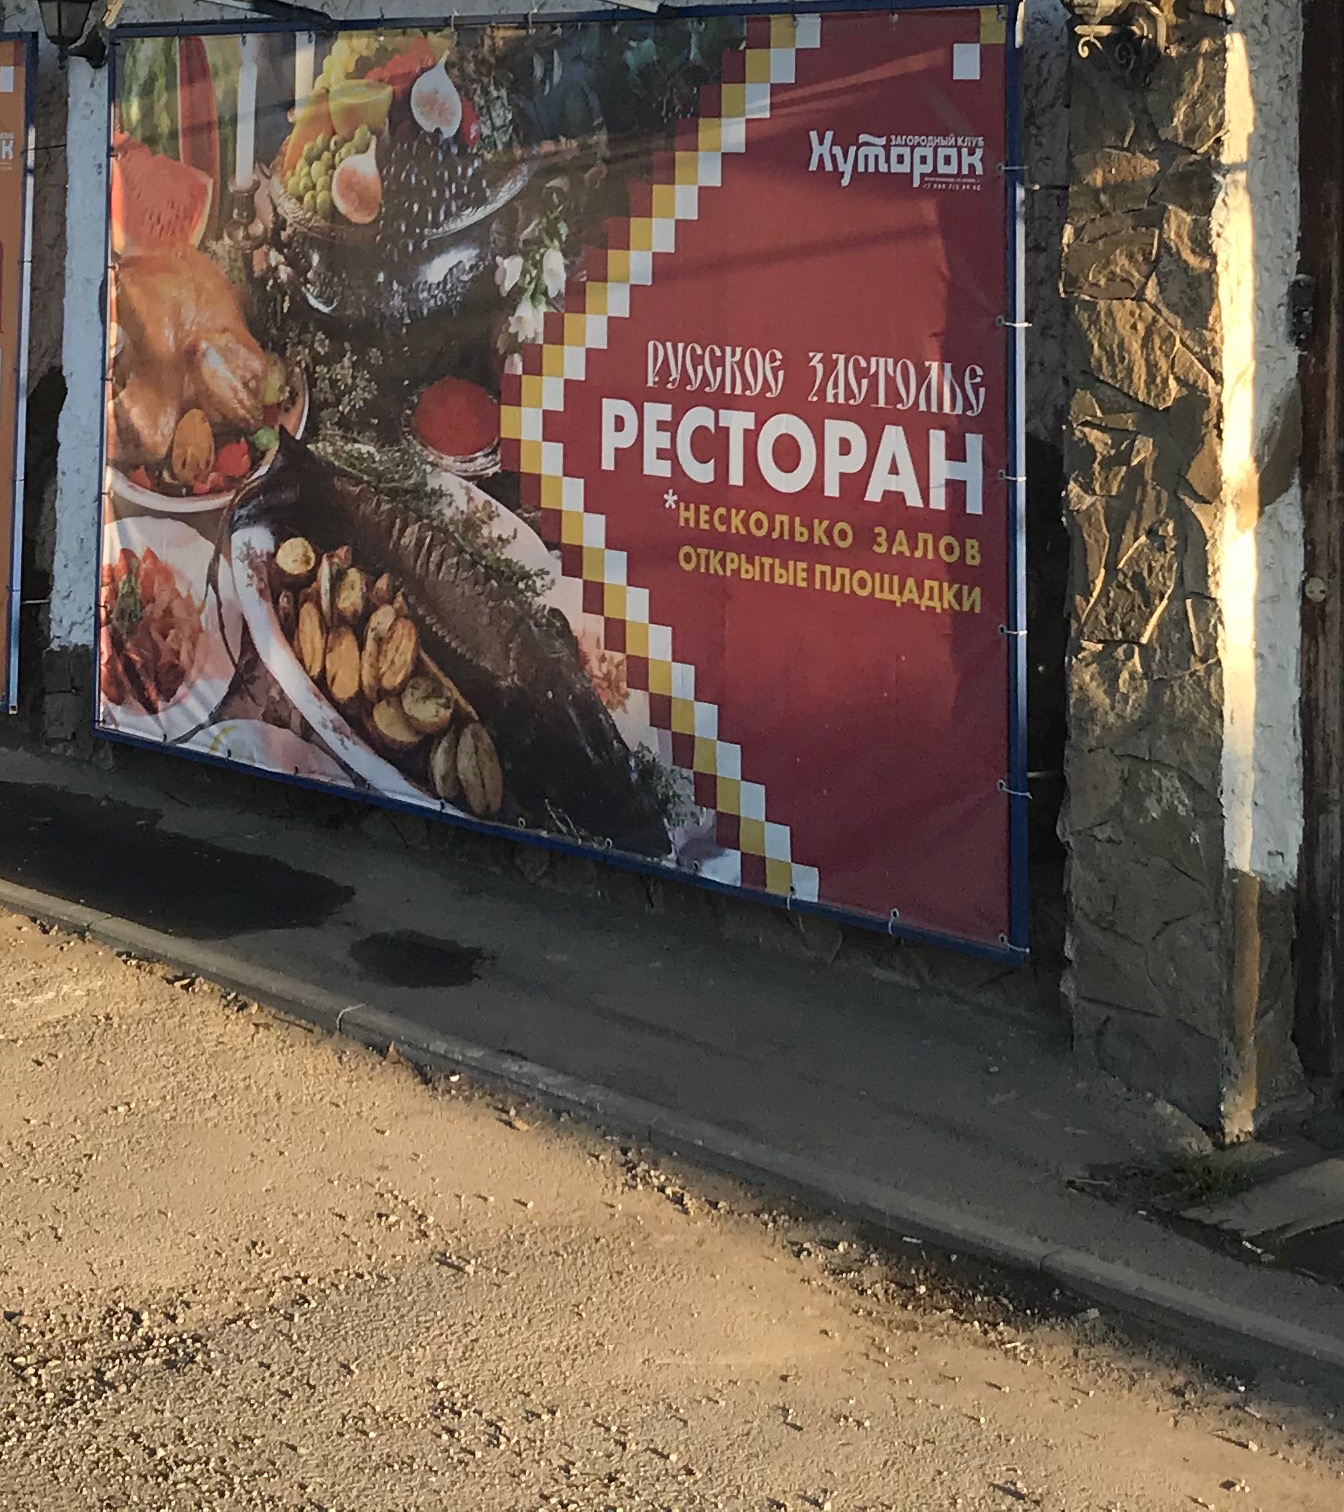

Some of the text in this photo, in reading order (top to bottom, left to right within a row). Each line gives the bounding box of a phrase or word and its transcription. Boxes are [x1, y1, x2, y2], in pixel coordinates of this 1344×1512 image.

[890, 133, 984, 148] ЗАГОРОДНЫЙ КЛУБ
[646, 340, 986, 417] РУССКОЕ ЗАСТОЛЬЕ
[601, 397, 984, 515] РЕСТОРАН
[678, 545, 981, 614] ОТКРЫТЫЕ ПЛОЩАДКИ
[872, 526, 981, 566] ЗАЛОВ
